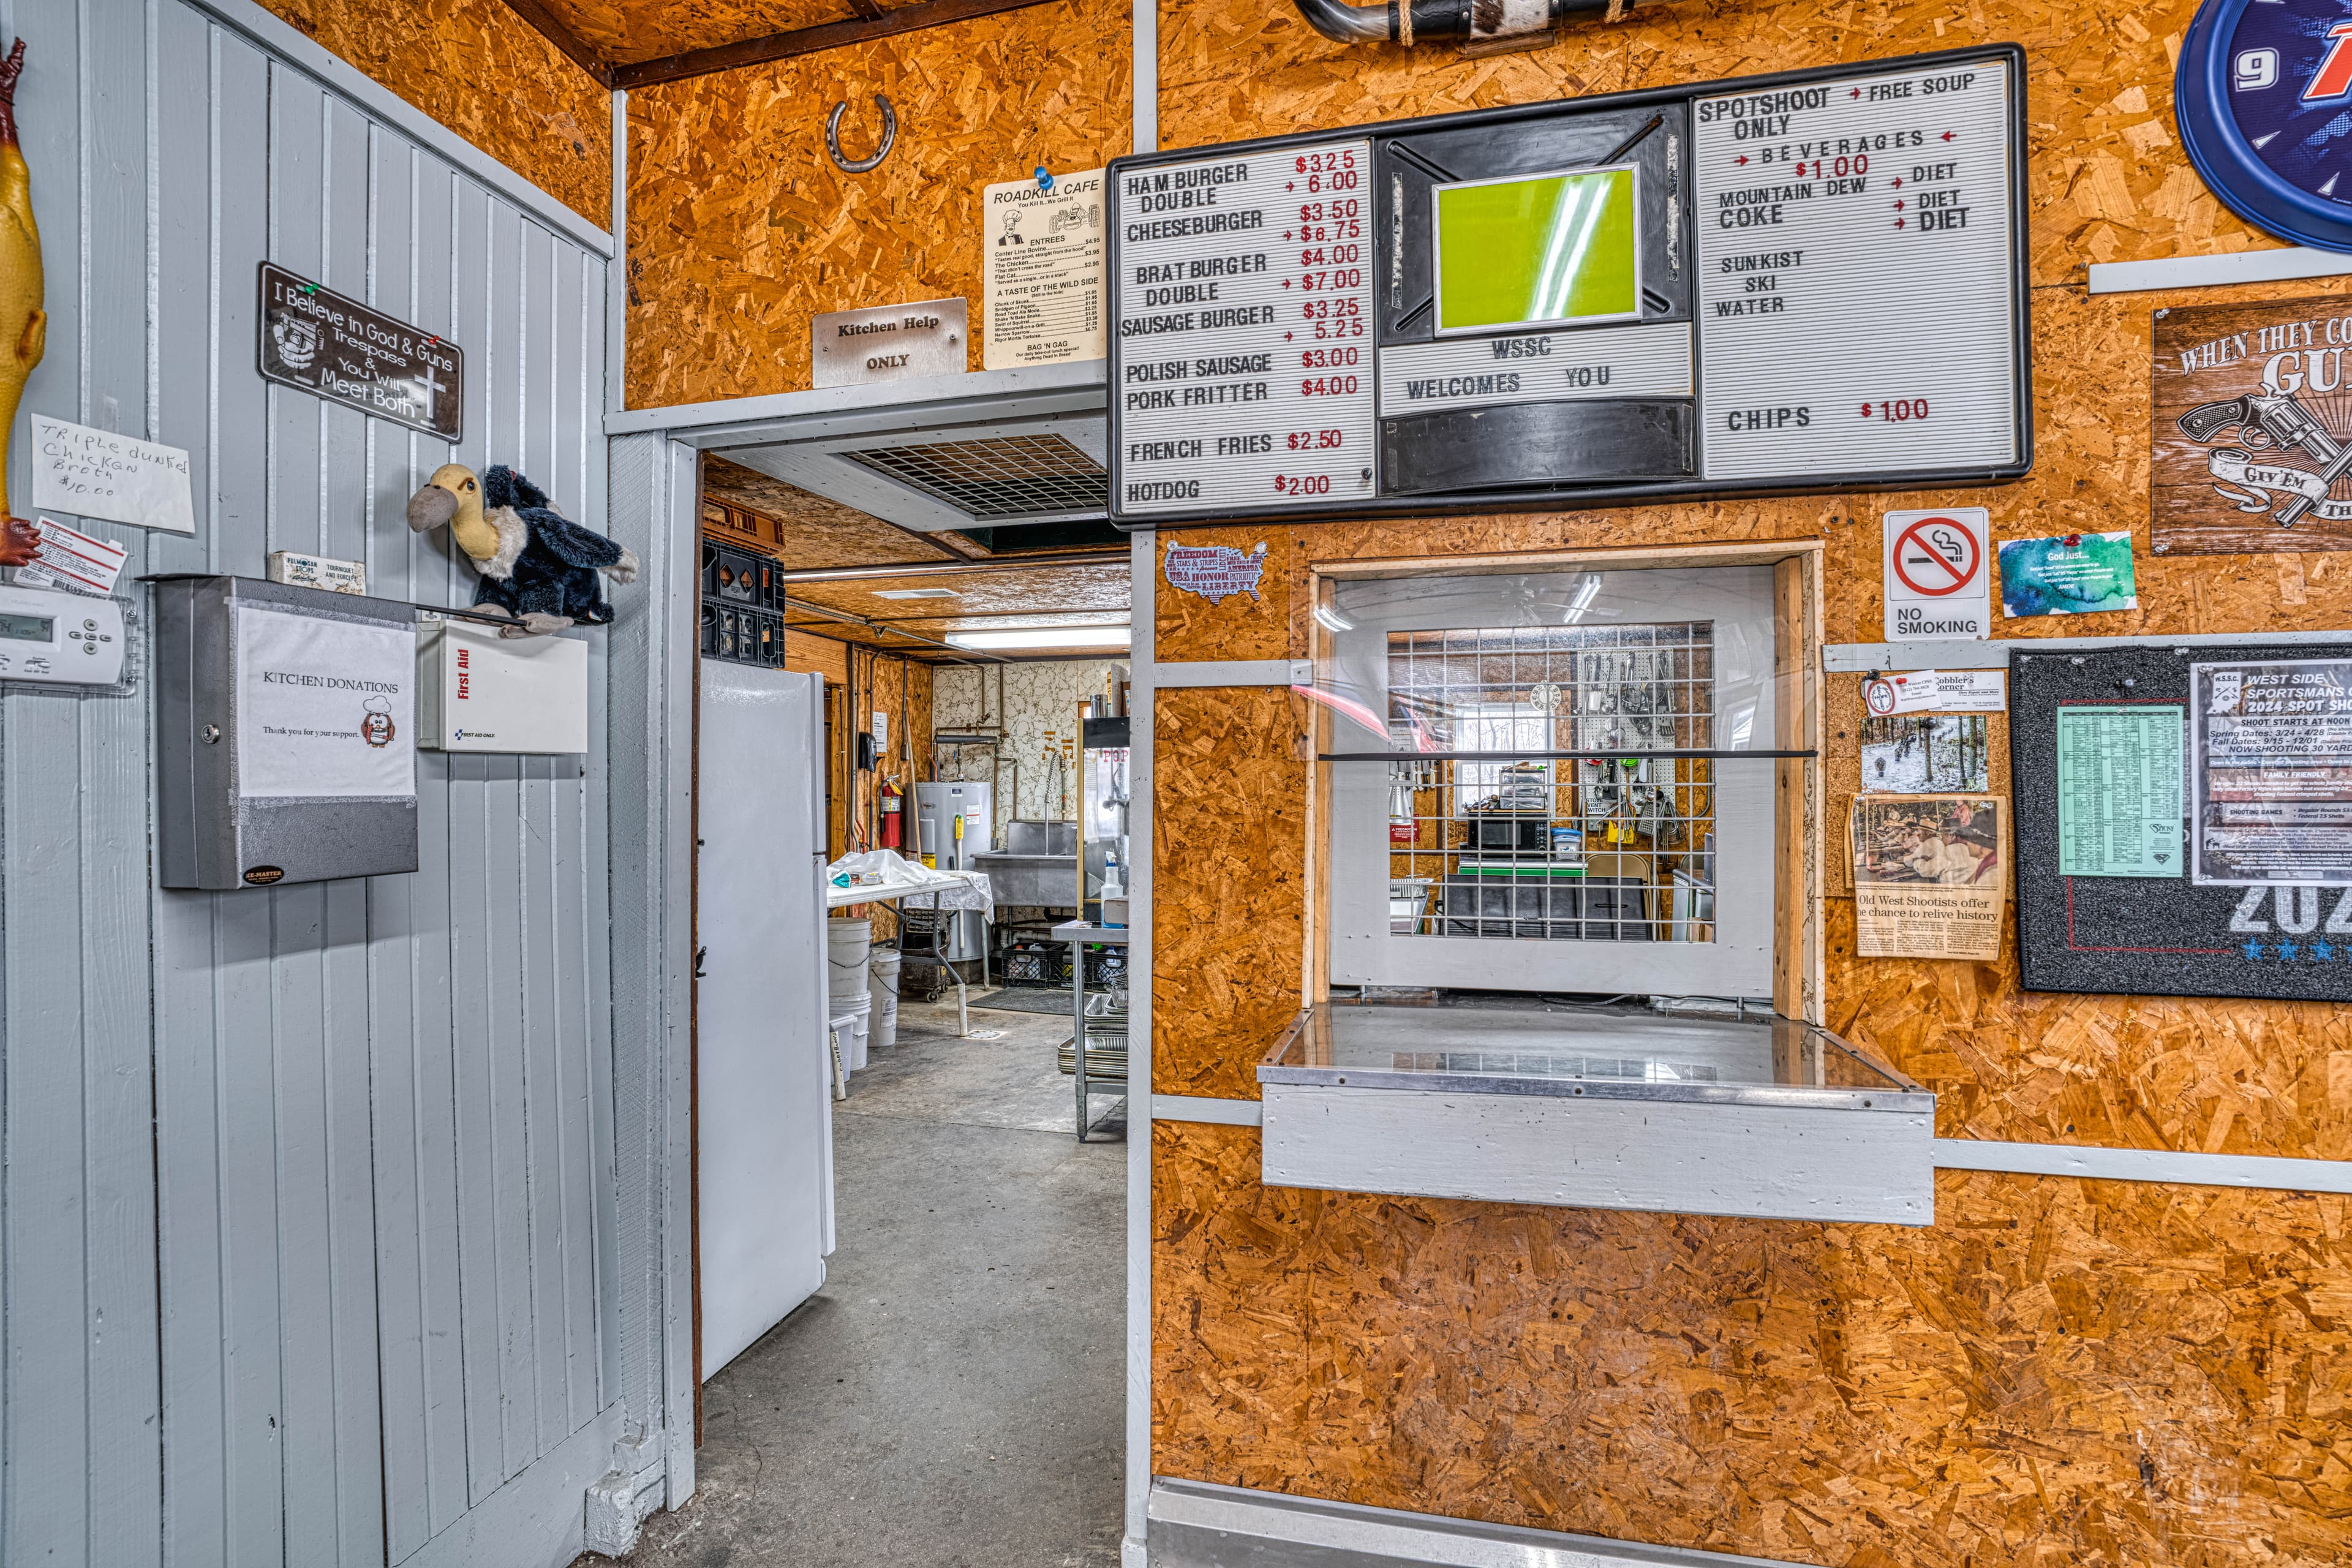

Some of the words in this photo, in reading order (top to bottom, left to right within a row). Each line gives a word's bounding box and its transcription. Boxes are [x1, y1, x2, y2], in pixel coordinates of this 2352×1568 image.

[2234, 47, 2279, 92] 9
[1870, 81, 1912, 102] FREE
[1923, 74, 1975, 95] SOUP
[1700, 87, 1831, 123] SPOTSHOOT
[1734, 115, 1790, 140] ONLY
[1762, 130, 1923, 164] BEVERAGES
[1295, 150, 1355, 173] $3.25
[1796, 154, 1868, 179] $1.00
[994, 186, 1060, 204] ROADKILL
[1065, 179, 1099, 195] CAFE
[1720, 183, 1812, 208] MOUNTAIN
[1827, 177, 1866, 197] DEW
[1913, 163, 1957, 182] DIET
[1141, 187, 1217, 213] DOUBLE
[1720, 205, 1783, 229] COKE
[1919, 189, 1960, 208] DIET
[1128, 210, 1262, 242] CHEESEBURGER
[1300, 199, 1358, 222] $3.50
[1300, 219, 1360, 242] $6.75
[1920, 208, 1969, 232] DIET
[1030, 235, 1065, 246] ENTREES
[1136, 262, 1185, 284] BRAT
[1191, 254, 1266, 278] BURGER
[1301, 244, 1359, 266] $4.00
[1722, 251, 1803, 273] SUNKIST
[1081, 277, 1098, 285] SIDE
[1146, 282, 1218, 306] DOUBLE
[1302, 269, 1360, 292] $7.00
[1746, 275, 1776, 292] SKI
[1121, 312, 1194, 337] SAUSAGE
[1200, 306, 1274, 329] BURGER
[1303, 298, 1359, 319] $3.25
[1716, 298, 1784, 316] WATER
[274, 282, 282, 301] I
[287, 288, 344, 326] Believe
[349, 316, 363, 335] in
[366, 323, 398, 350] God
[402, 338, 413, 356] &
[417, 344, 453, 371] Guns
[838, 321, 897, 337] Kitchen
[904, 316, 939, 330] Help
[1315, 318, 1363, 339] 5.25
[333, 326, 407, 368] Trespass
[1492, 336, 1551, 359] WSSC
[2180, 331, 2250, 377] WHEN
[2258, 319, 2318, 355] THEY
[365, 358, 375, 370] &
[866, 354, 910, 369] ONLY
[1126, 360, 1188, 383] POLISH
[1196, 354, 1272, 377] SAUSAGE
[1302, 347, 1358, 368] $3.00
[338, 357, 370, 380] You
[374, 371, 401, 391] Will
[1408, 372, 1520, 399] WELCOMES
[1566, 366, 1610, 387] YOU
[320, 368, 369, 400] Meet
[374, 387, 415, 418] Both
[1127, 390, 1175, 410] PORK
[1184, 382, 1267, 405] FRITTER
[1302, 375, 1357, 396] $4.00
[1728, 407, 1810, 431] CHIPS
[1861, 399, 1928, 423] $1.00
[1131, 439, 1202, 461] FRENCH
[1218, 434, 1272, 456] FRIES
[1287, 429, 1342, 451] $2.50
[1128, 480, 1199, 502] HOTDOG
[1275, 475, 1329, 496] $2.00
[1170, 550, 1218, 559] FREEDOM
[2048, 552, 2064, 561] God
[2065, 551, 2089, 560] Just...
[327, 565, 354, 573] TOURNIQUET
[1169, 571, 1190, 581] USA
[1192, 572, 1229, 581] HONOR
[1230, 572, 1257, 581] PATRIOTIC
[1202, 581, 1254, 591] LIBERTY
[1898, 608, 1921, 620] NO
[1898, 620, 1977, 634] SMOKING
[458, 649, 469, 669] Aid
[263, 671, 323, 687] KITCHEN
[327, 678, 398, 693] DONATIONS
[458, 673, 469, 699] First
[2247, 675, 2288, 685] WEST
[2292, 673, 2324, 684] SIDE
[2246, 687, 2345, 698] SPORTSMANS
[2248, 701, 2284, 713] 2024
[2288, 700, 2324, 712] SPOT
[1104, 750, 1128, 762] POP
[1859, 895, 1875, 905] Old
[1879, 896, 1904, 905] West
[1907, 897, 1958, 907] Shootists
[1961, 899, 1990, 908] offer
[1869, 908, 1906, 917] chance
[1923, 908, 1954, 919] relive
[1957, 910, 1999, 922] history
